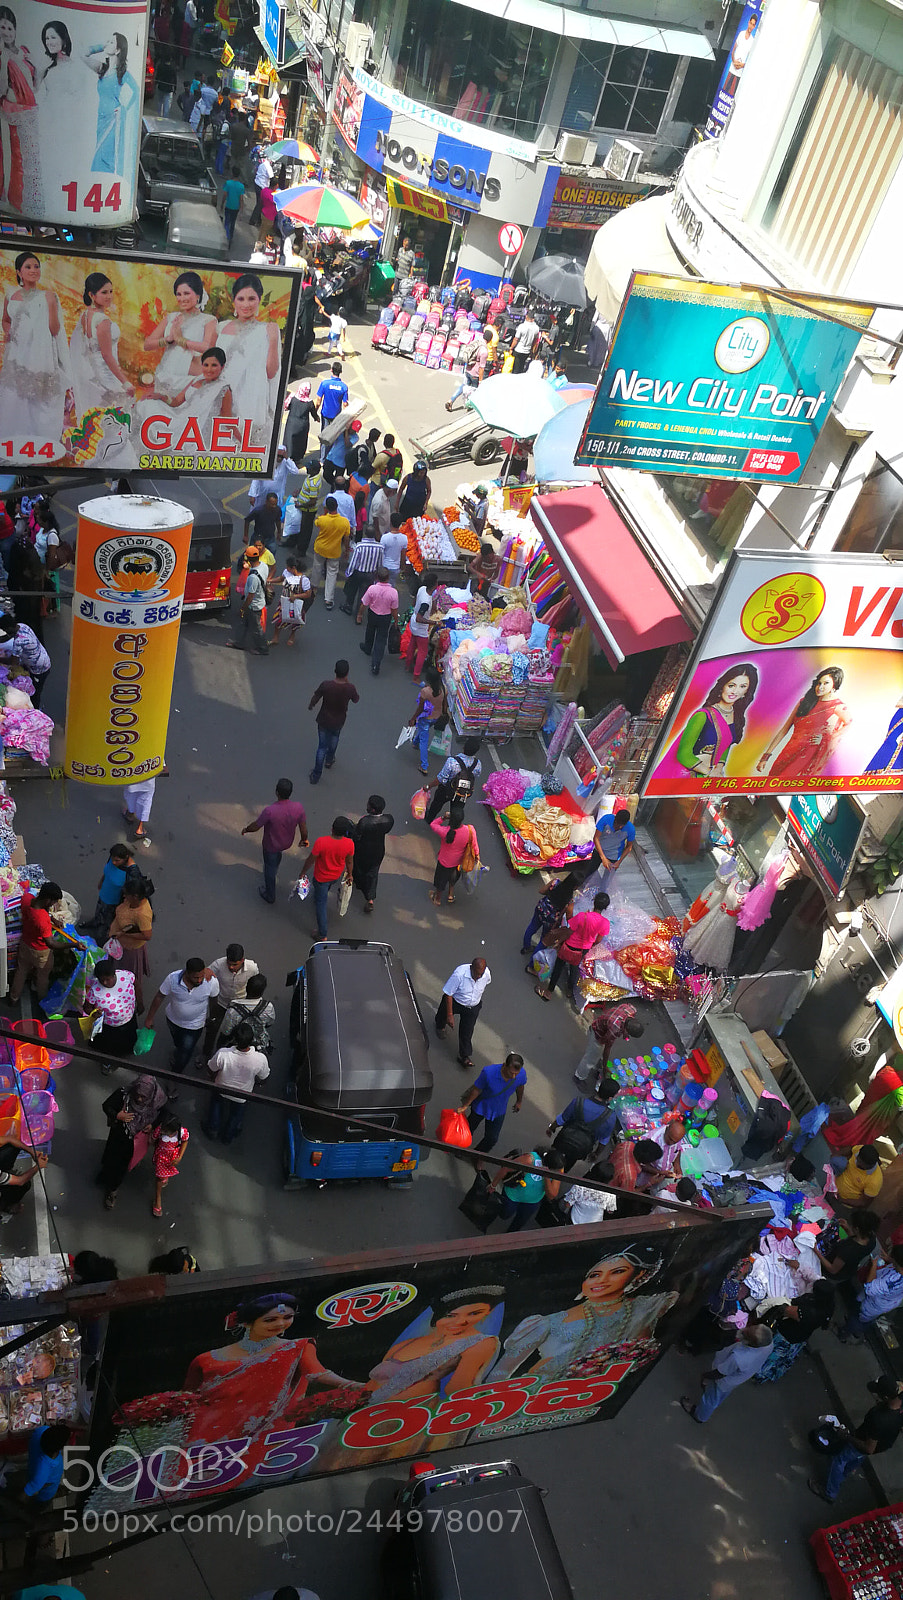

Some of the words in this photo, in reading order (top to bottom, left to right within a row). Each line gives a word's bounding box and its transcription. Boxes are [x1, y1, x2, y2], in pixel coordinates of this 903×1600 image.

[355, 68, 388, 99] ROYAL
[391, 94, 464, 134] SUITING
[61, 182, 122, 212] 144
[561, 187, 585, 203] ONE
[728, 326, 759, 359] City
[610, 368, 684, 404] New
[687, 378, 747, 418] City
[751, 385, 826, 420] Point
[140, 415, 267, 455] GAEL
[615, 419, 636, 428] PARTY
[636, 421, 662, 430] FROCKS
[718, 430, 747, 439] Wholesale
[753, 433, 771, 442] Retail
[771, 435, 792, 443] Dealers
[1, 440, 56, 459] 144
[636, 446, 661, 458] CROSS
[662, 448, 690, 462] STREET,
[139, 455, 195, 471] SAREE
[194, 456, 263, 472] MANDIR
[715, 779, 738, 790] 146,
[742, 778, 766, 789] 2nd
[769, 777, 806, 788] Cross
[808, 777, 845, 789] Street,
[848, 776, 901, 787] Colombo
[826, 837, 849, 871] Point
